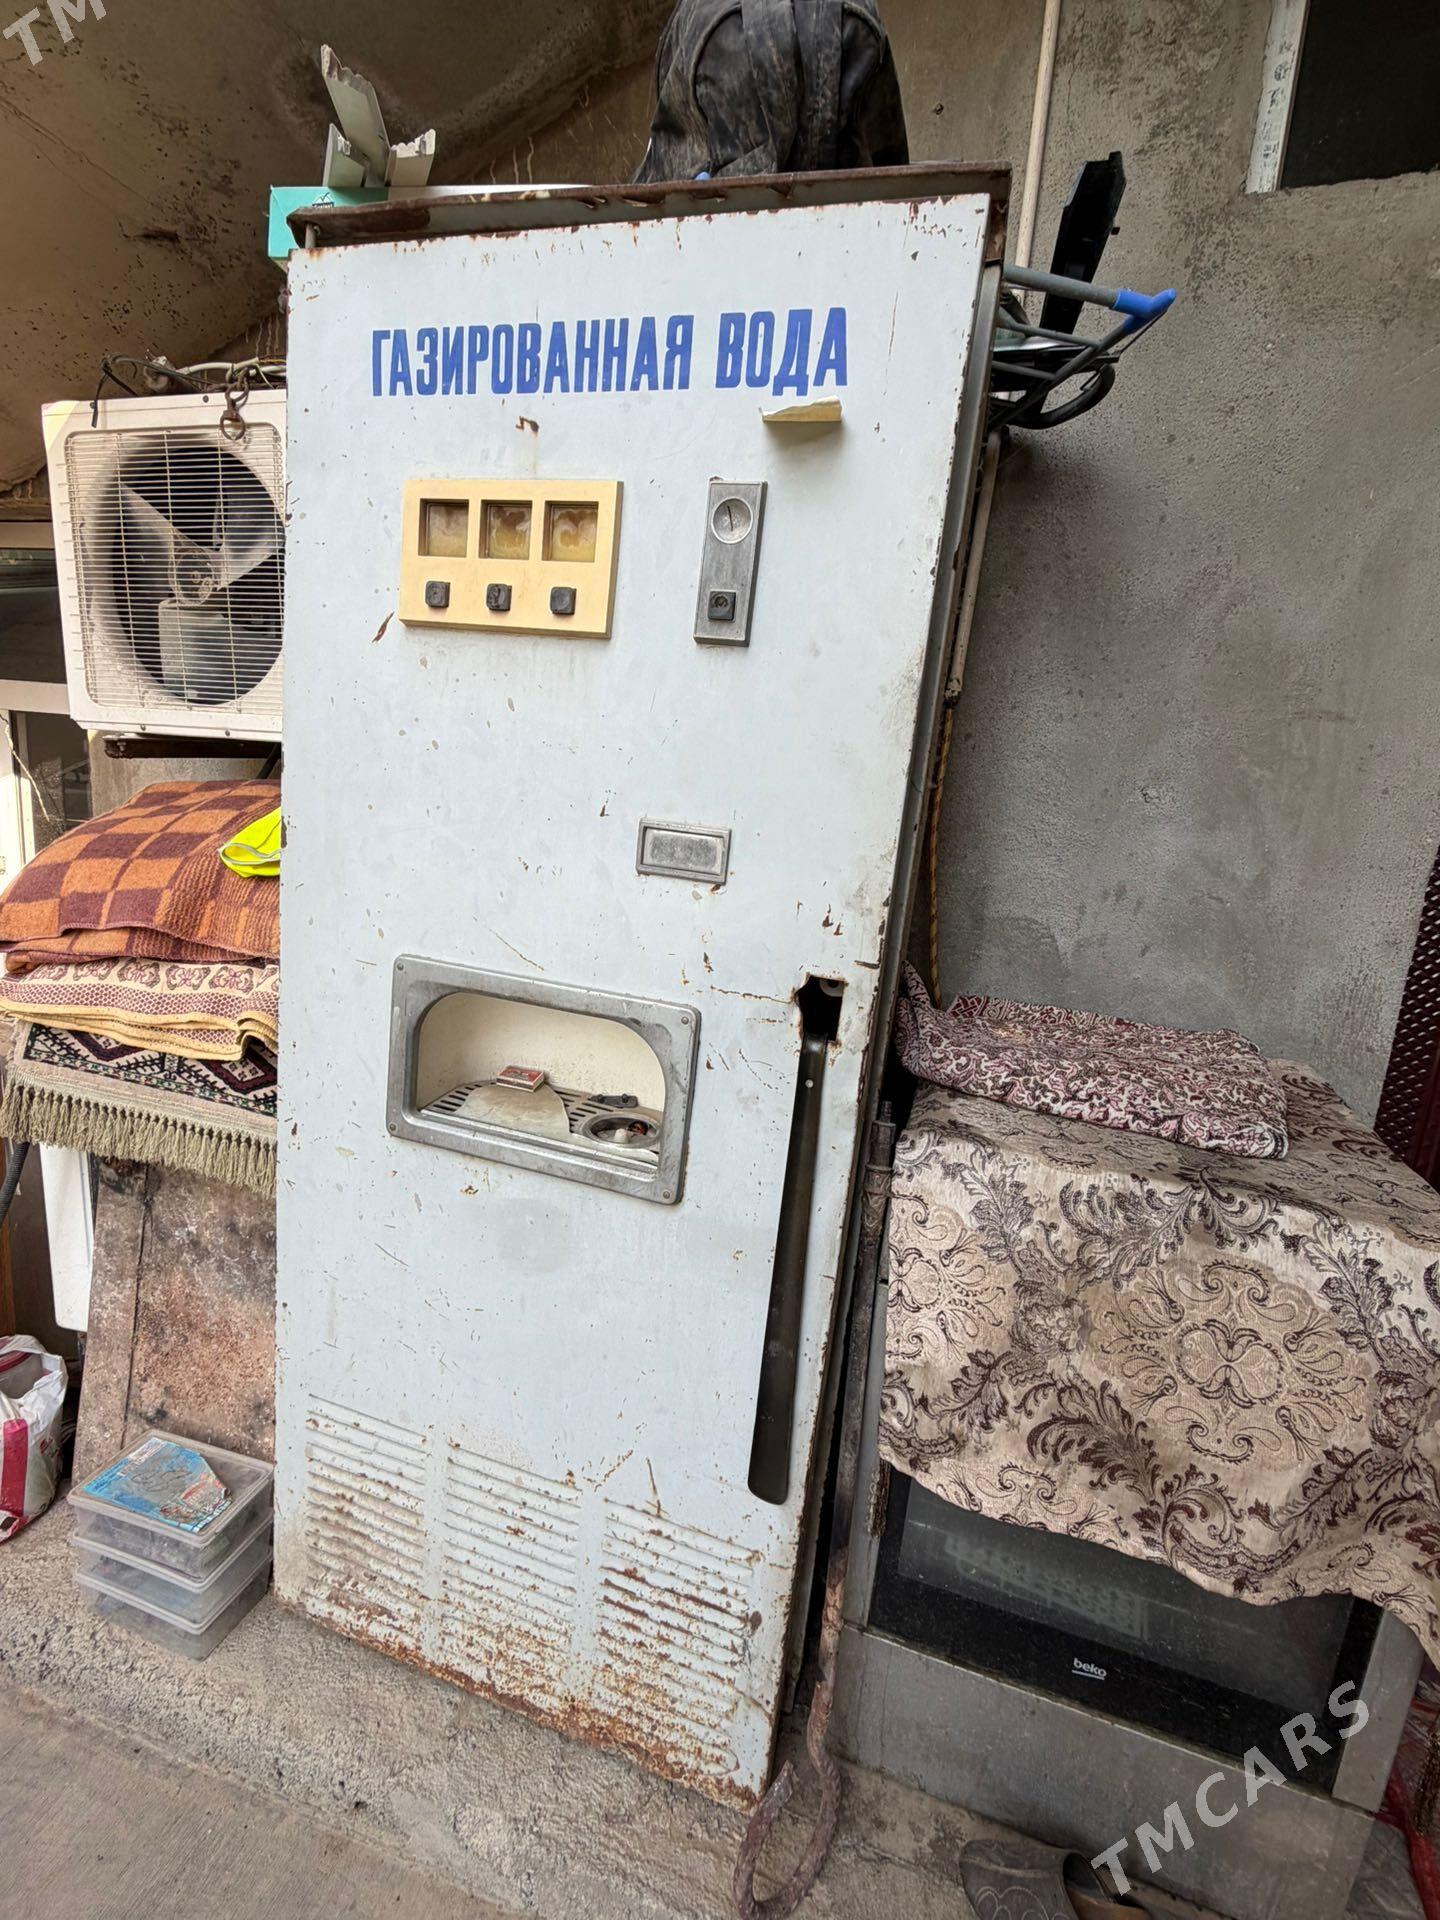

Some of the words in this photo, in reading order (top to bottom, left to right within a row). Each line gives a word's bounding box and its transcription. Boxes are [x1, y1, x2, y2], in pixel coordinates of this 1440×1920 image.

[372, 315, 694, 396] ГАЗИРОВАННАЯ
[715, 307, 848, 396] ВОДА
[1073, 1657, 1107, 1677] beko
